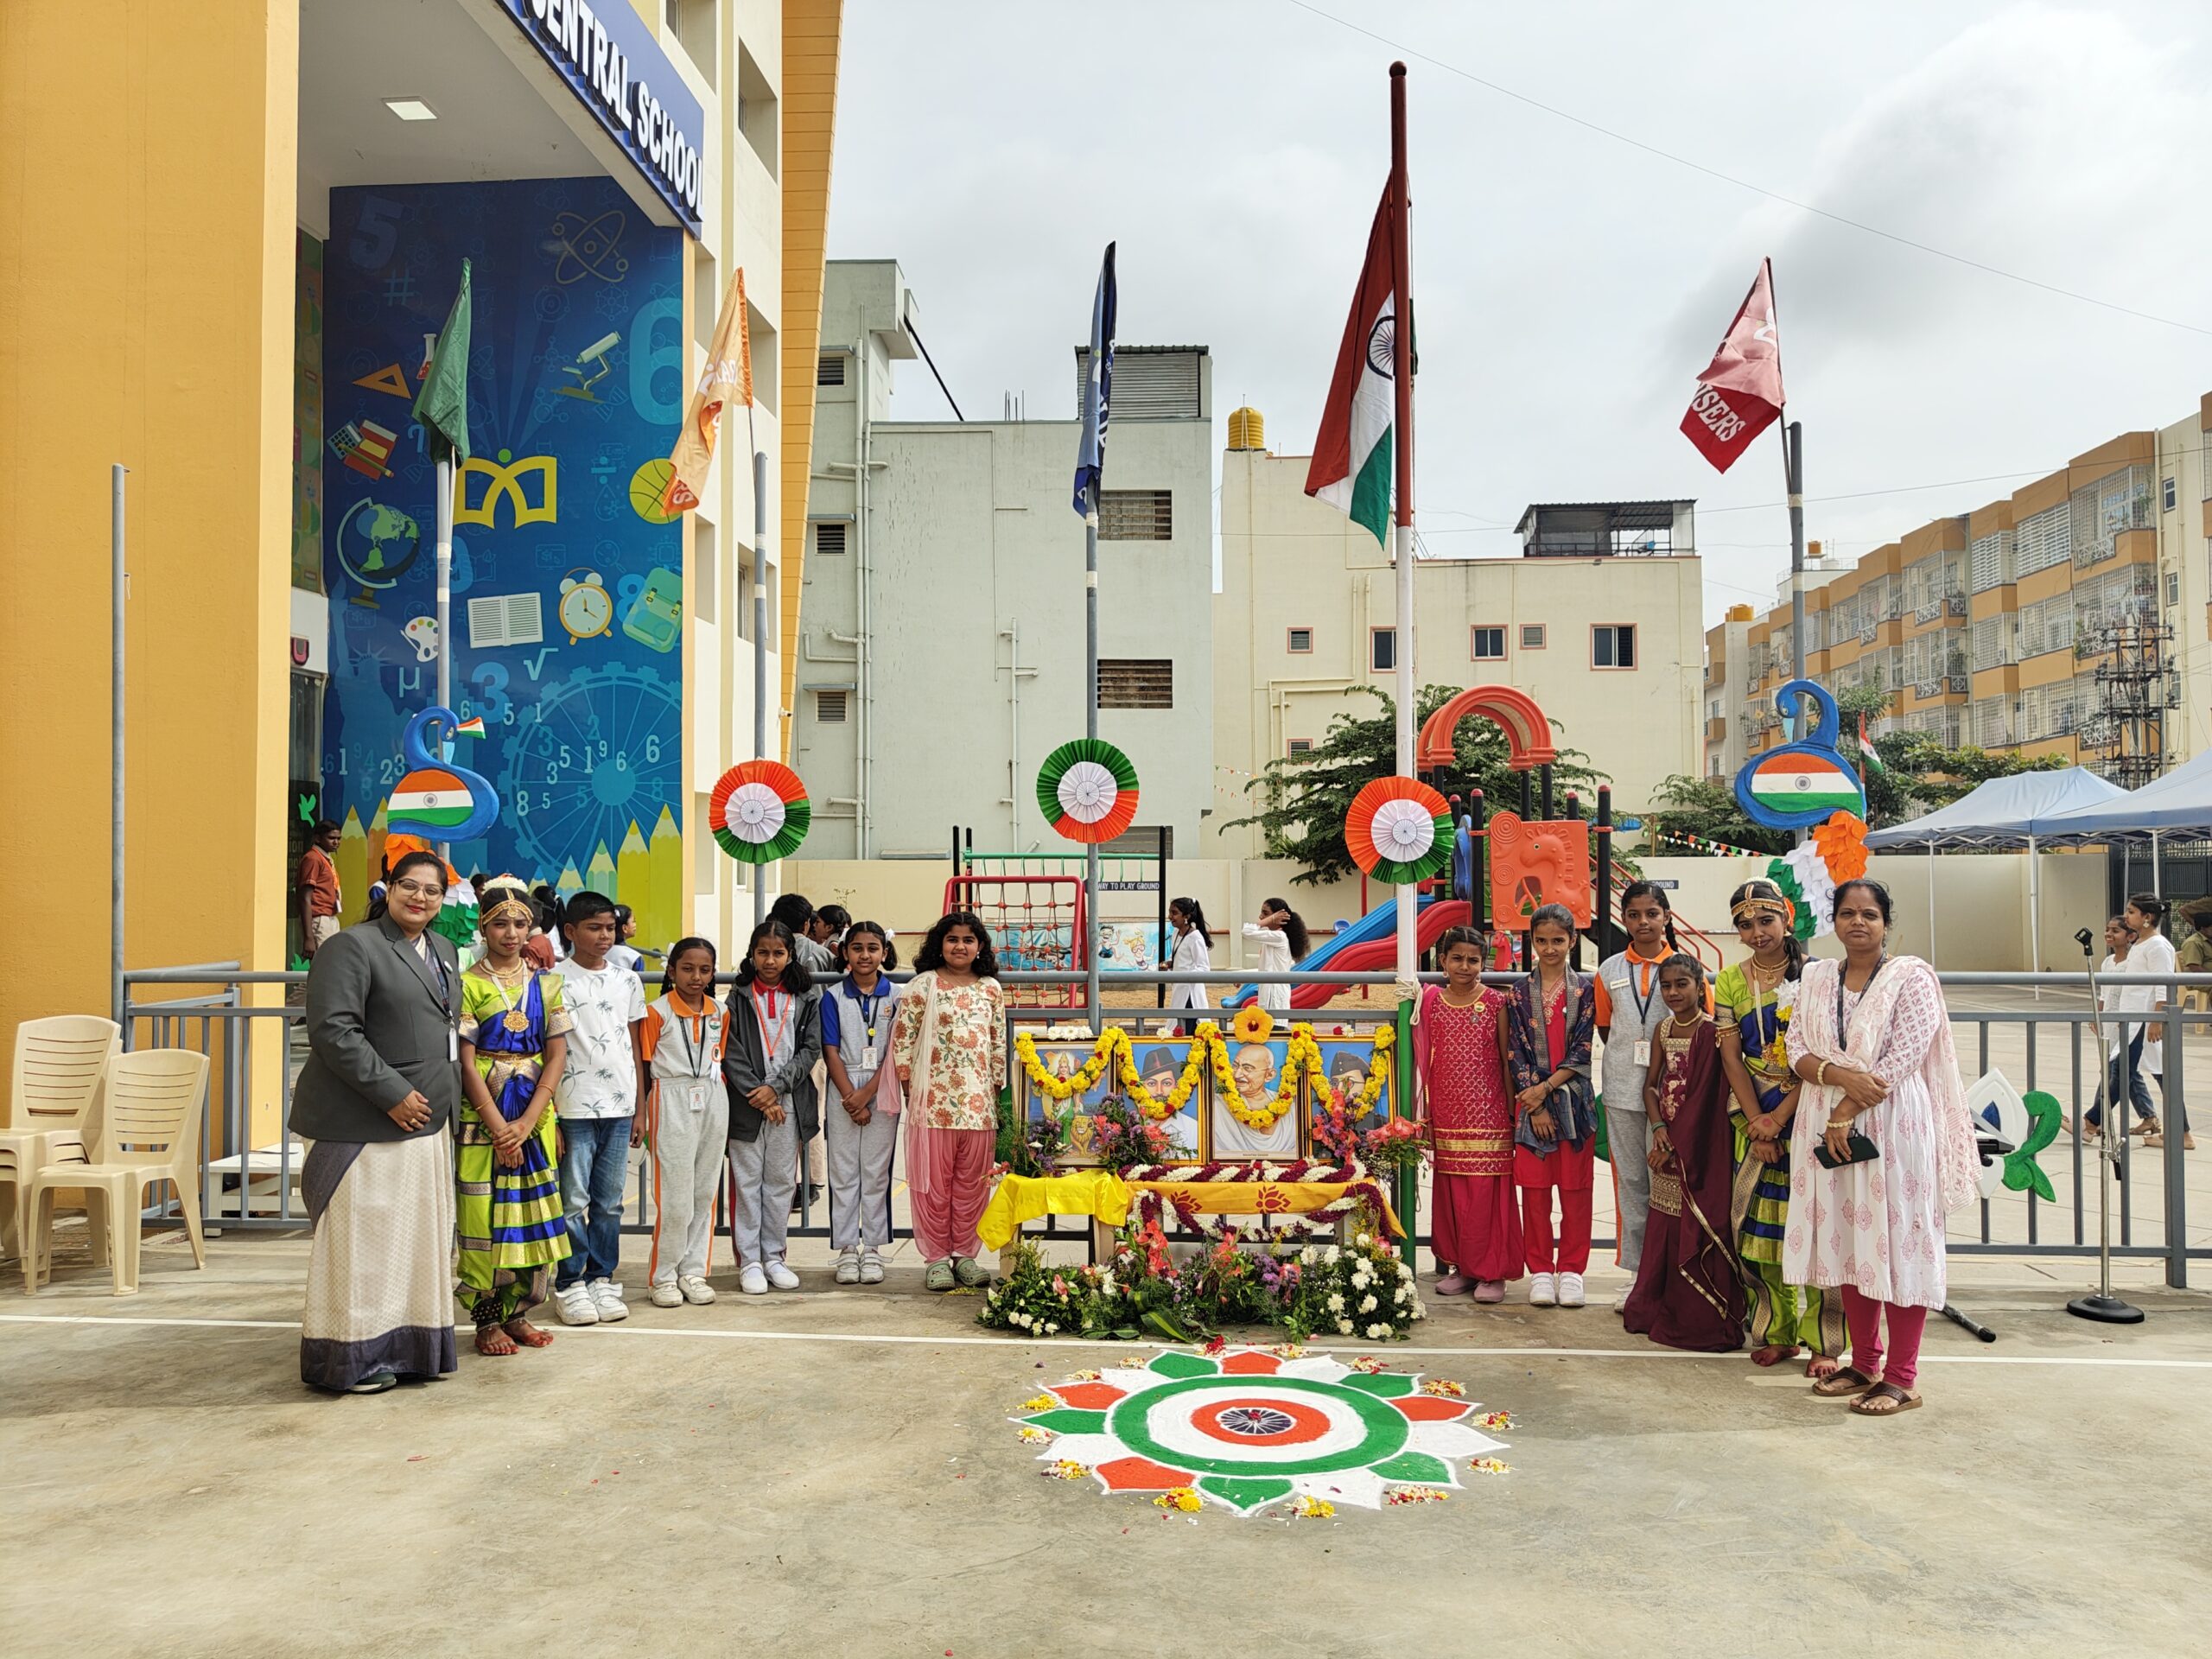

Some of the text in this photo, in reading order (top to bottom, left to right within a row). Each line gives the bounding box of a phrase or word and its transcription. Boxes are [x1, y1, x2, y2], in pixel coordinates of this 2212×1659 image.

[637, 81, 704, 222] SCHOOL
[471, 662, 510, 724] 3
[460, 701, 471, 720] 6
[503, 703, 515, 725] 5
[535, 702, 542, 722] 1
[559, 746, 571, 768] 5
[584, 747, 594, 773] 1
[599, 741, 607, 757] 9
[646, 734, 660, 763] 6
[339, 748, 348, 775] 1
[380, 759, 393, 785] 2
[394, 753, 405, 777] 3
[616, 751, 627, 772] 6
[547, 762, 558, 785] 3
[517, 791, 529, 816] 8
[542, 792, 550, 809] 5
